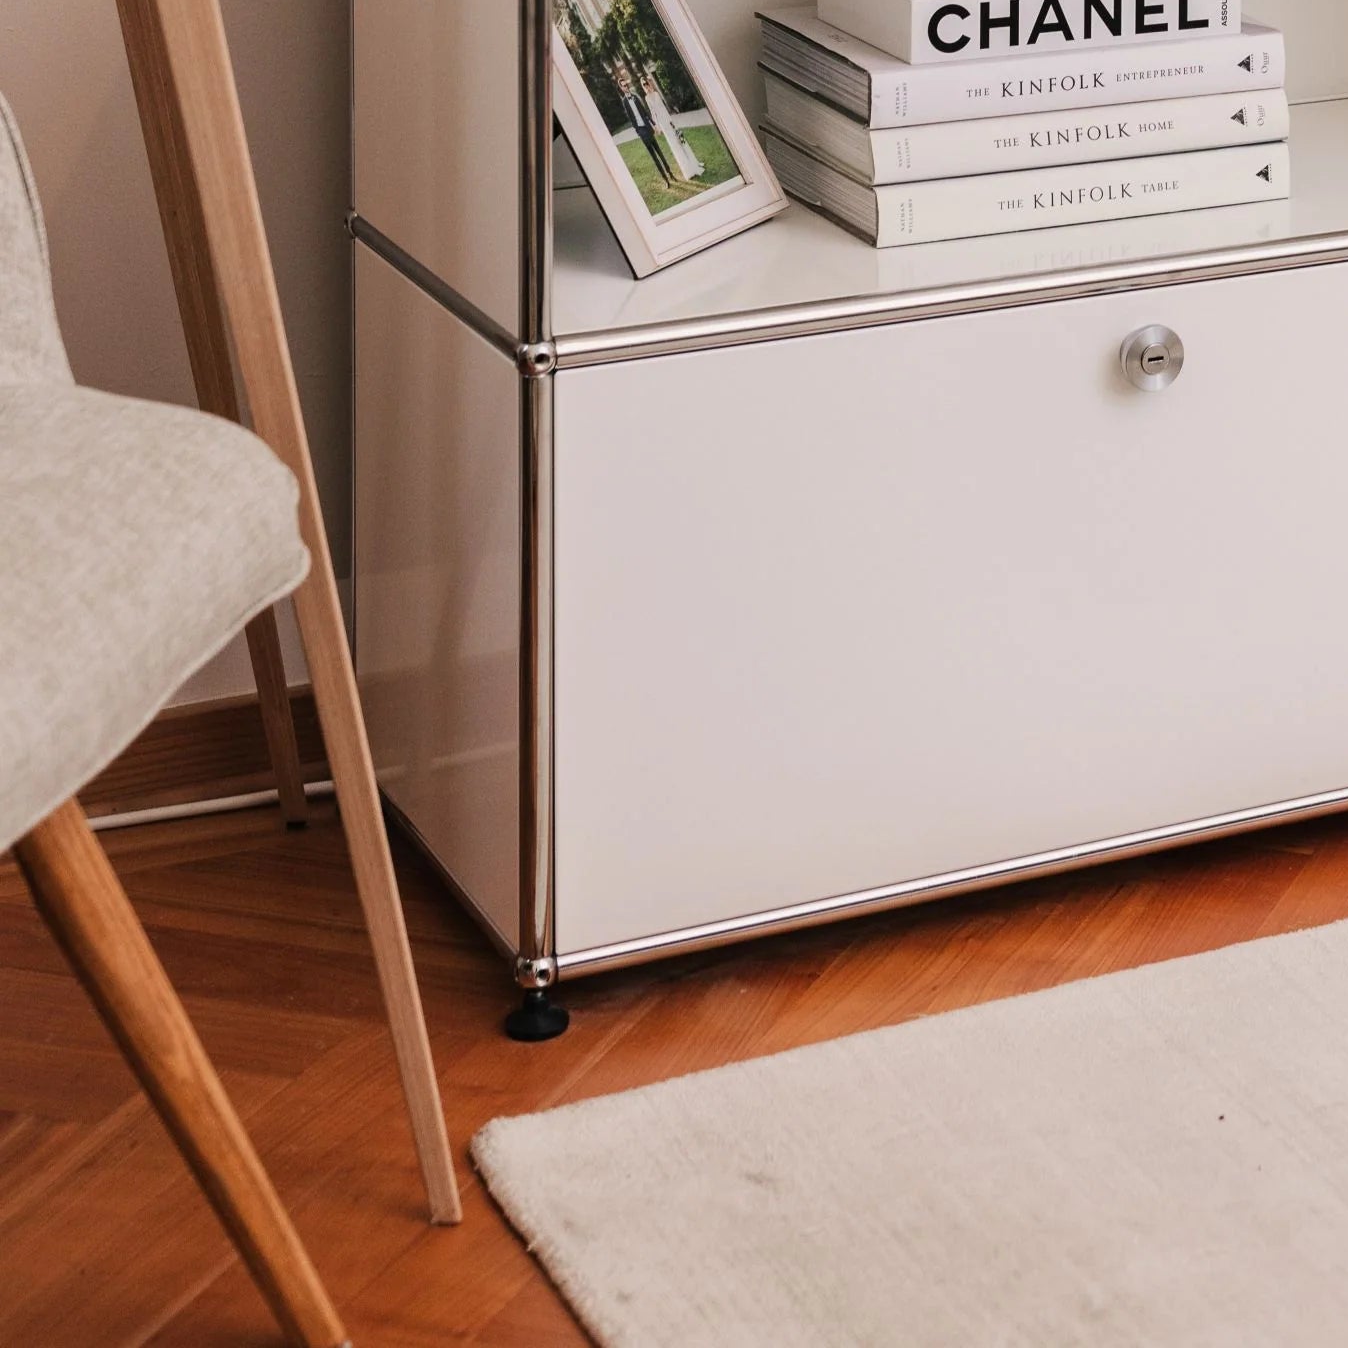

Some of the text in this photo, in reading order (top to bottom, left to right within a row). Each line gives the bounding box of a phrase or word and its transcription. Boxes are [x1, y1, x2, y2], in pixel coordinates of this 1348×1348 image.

[966, 65, 1205, 98] THE KINFOLK ENTREPRENEUR
[993, 121, 1175, 149] THE KINFOLK HOME
[998, 180, 1180, 211] THE KINFOLK TABLE
